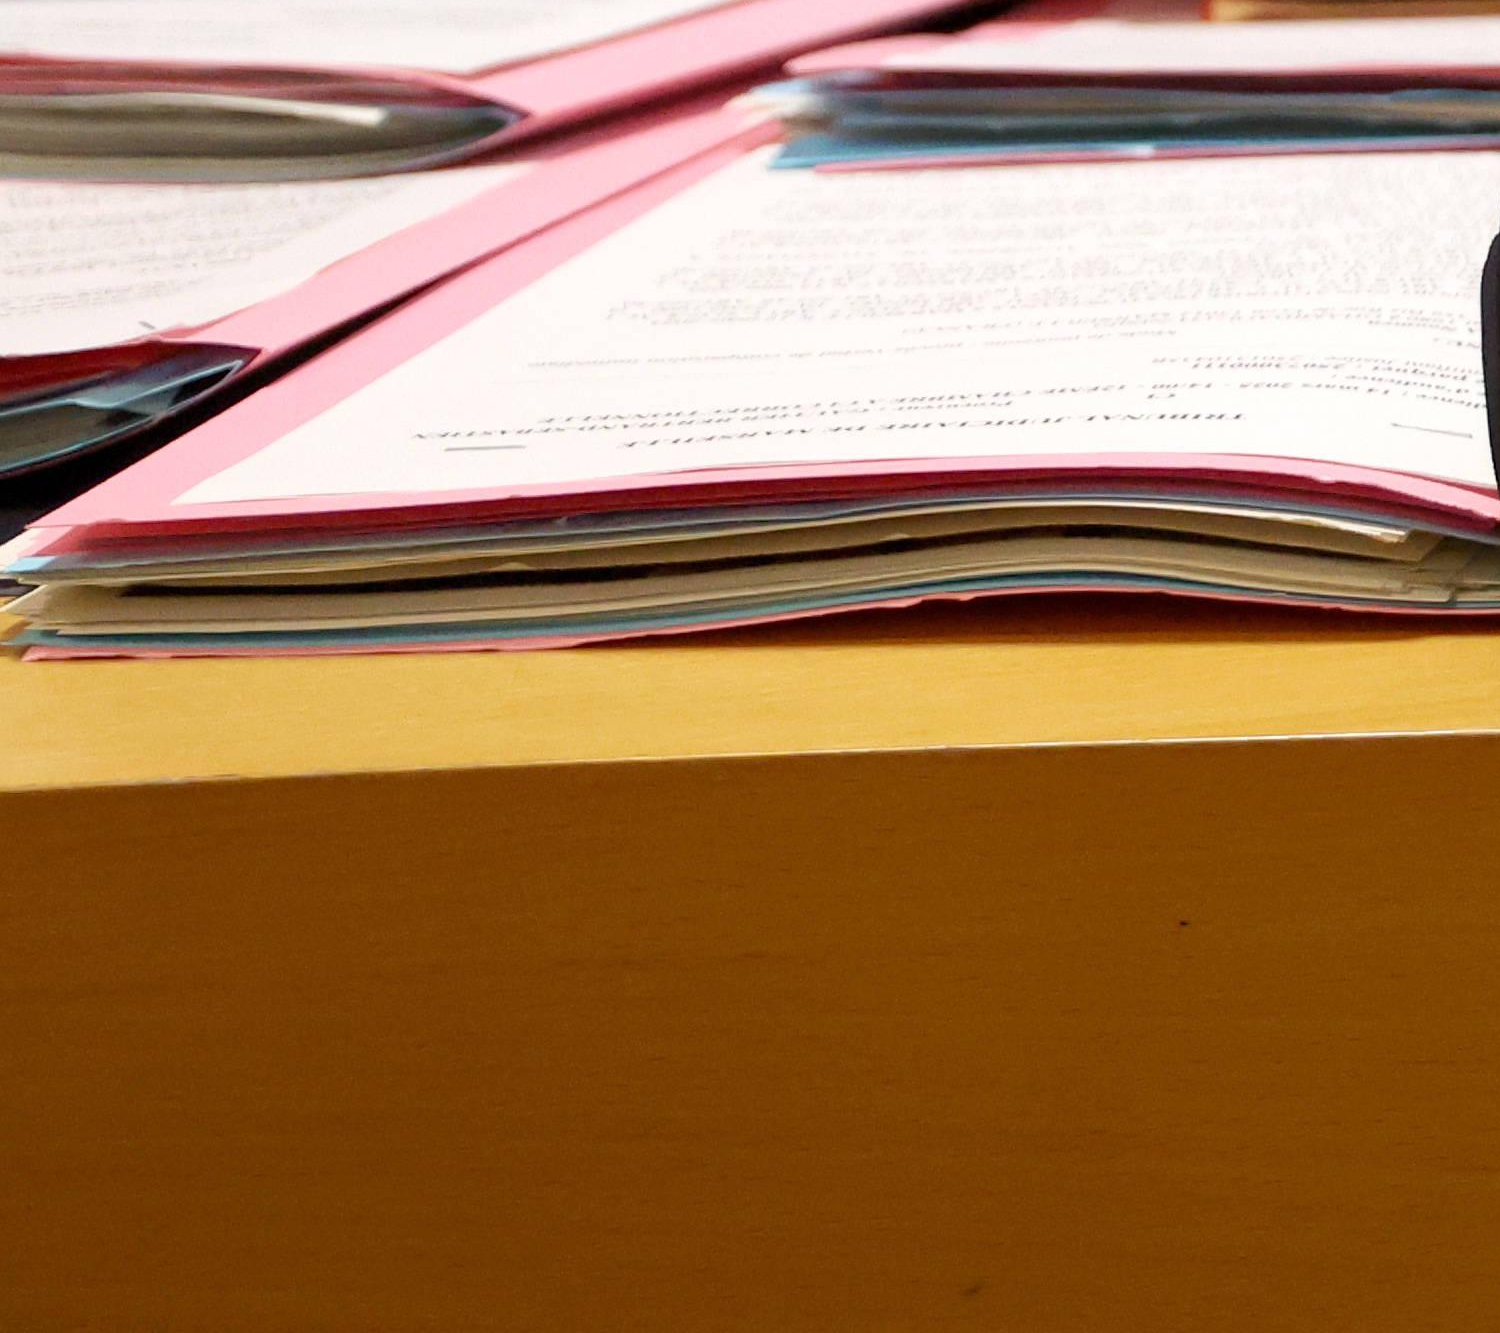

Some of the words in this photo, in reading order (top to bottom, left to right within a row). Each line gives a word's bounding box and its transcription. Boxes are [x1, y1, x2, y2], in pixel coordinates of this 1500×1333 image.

[1372, 366, 1467, 382] parquet
[1346, 376, 1469, 395] d'audience
[890, 391, 1032, 404] CHAMBRE
[1417, 395, 1486, 410] dience
[538, 403, 822, 424] CORRECTIONNELLE
[1081, 413, 1246, 422] TRIBUNAL
[880, 416, 1071, 430] JUDICIAIRE
[617, 428, 814, 449] MARSEILLE
